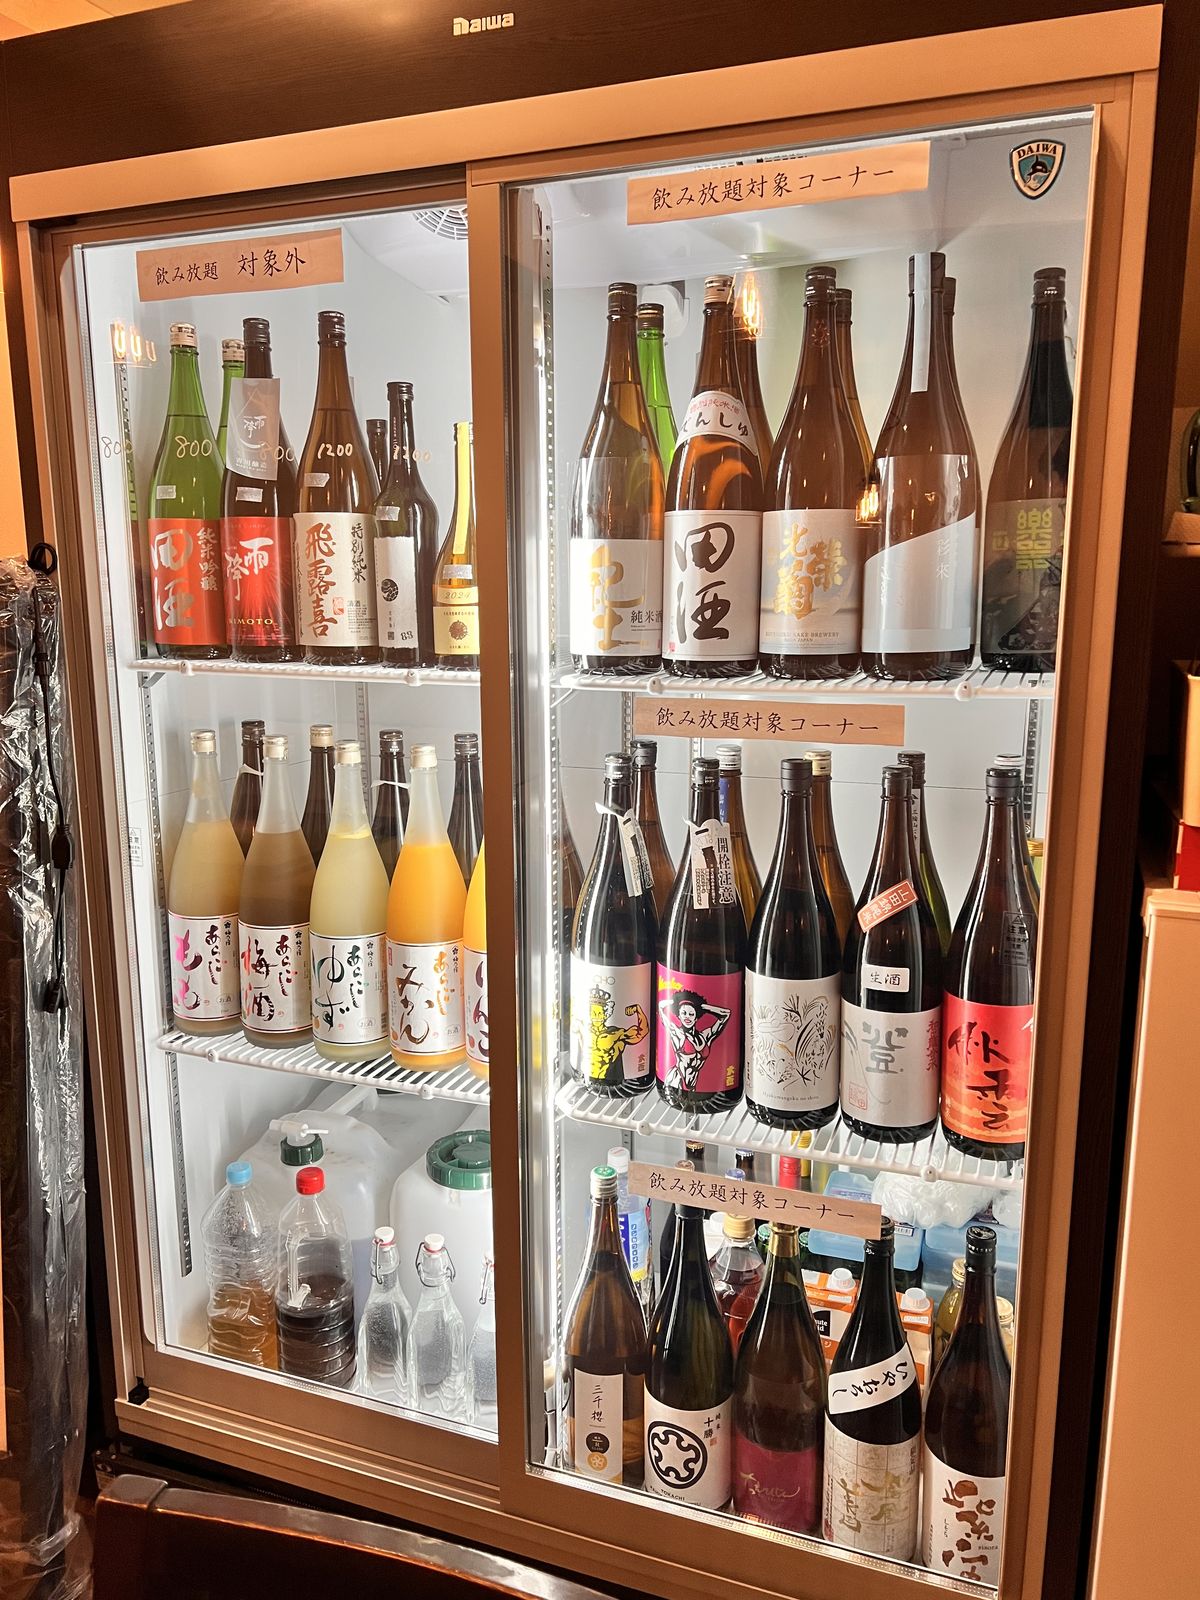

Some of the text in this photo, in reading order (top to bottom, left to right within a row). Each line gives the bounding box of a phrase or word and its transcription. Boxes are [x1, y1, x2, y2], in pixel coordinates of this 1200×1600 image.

[453, 13, 514, 36] Daiwa
[1017, 144, 1057, 158] DAIWA
[652, 165, 894, 211] 飲み放題対象コーナー
[155, 247, 306, 286] 飲み放題 対象外
[174, 435, 213, 458] 800
[317, 443, 353, 460] 1200
[351, 523, 367, 584] 特別純米
[151, 529, 194, 631] 田酒
[306, 522, 337, 638] 飛露喜
[674, 522, 735, 644] 田酒
[656, 706, 879, 736] 飲み放題対象コーナー
[718, 838, 734, 904] 開栓注意
[311, 944, 350, 1032] ゆず
[870, 972, 900, 987] 生酒
[649, 1171, 855, 1220] 飲み放題対象コーナー
[704, 1417, 714, 1439] 十勝
[660, 1489, 685, 1501] TOKACHI
